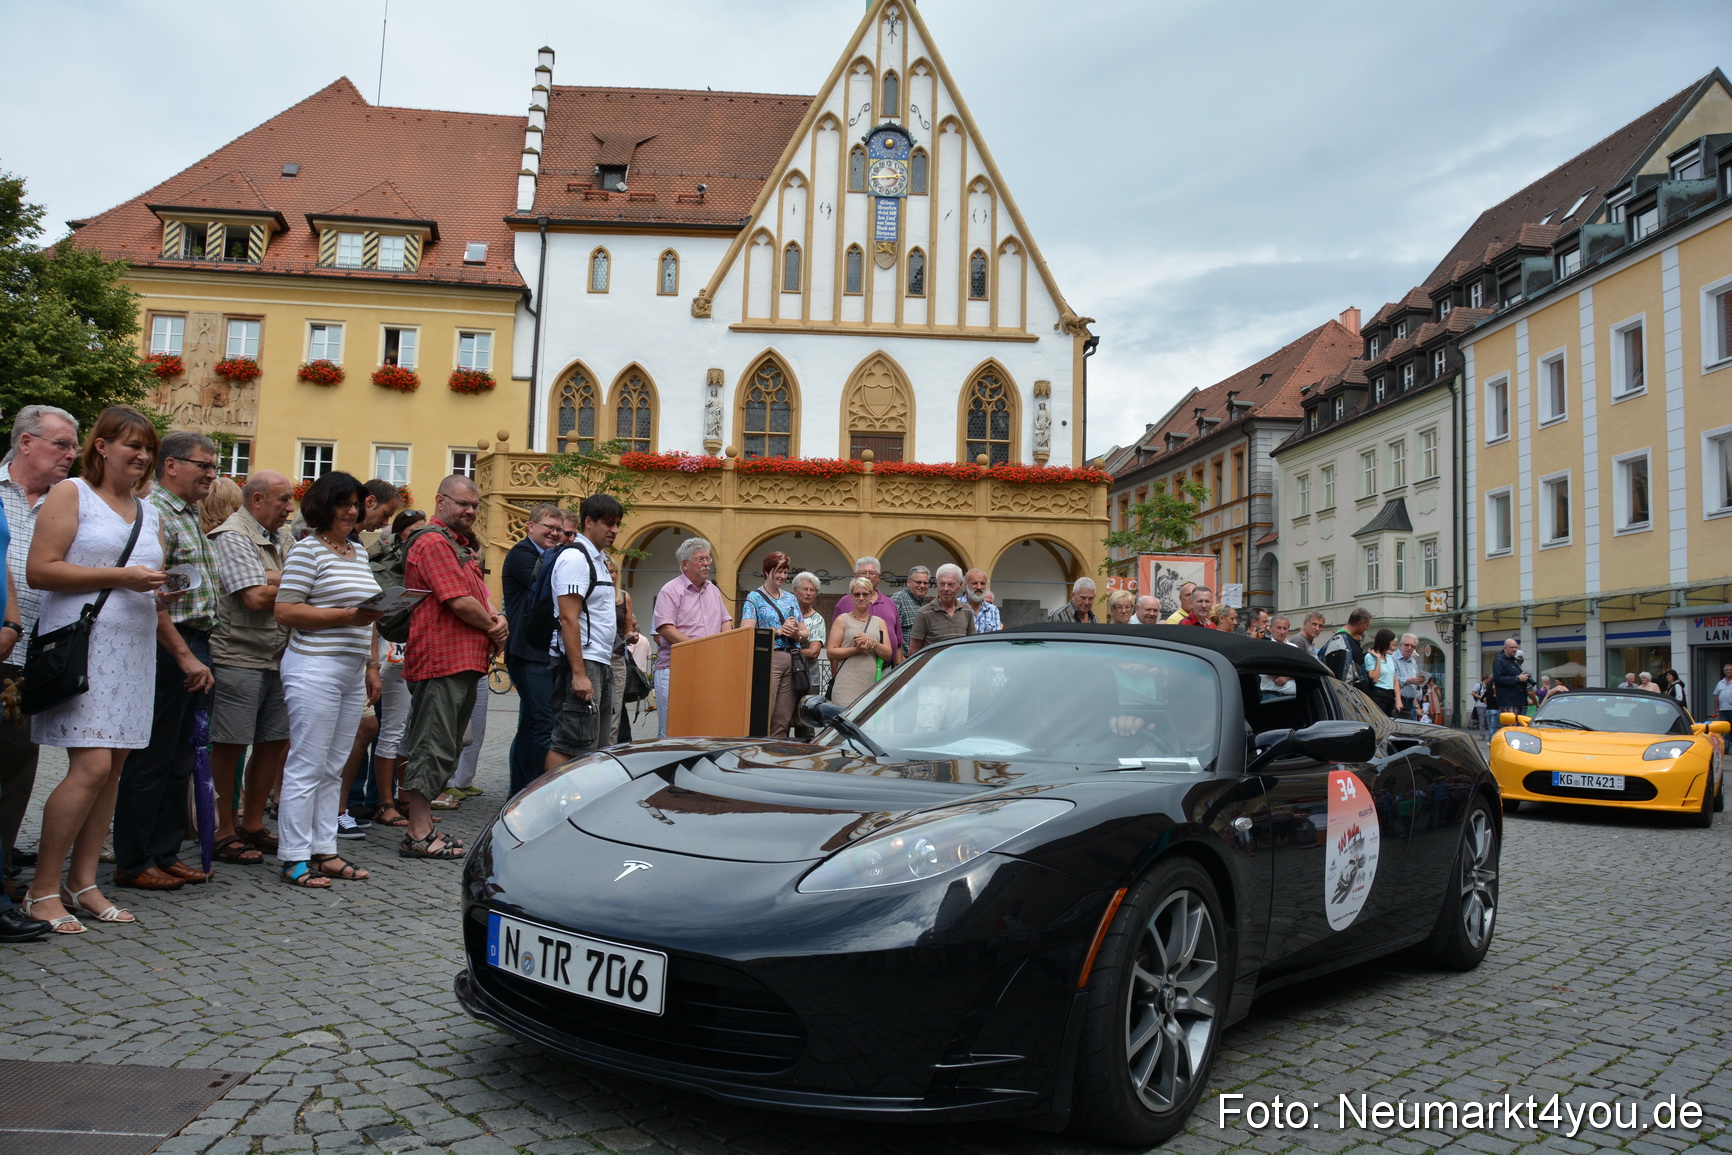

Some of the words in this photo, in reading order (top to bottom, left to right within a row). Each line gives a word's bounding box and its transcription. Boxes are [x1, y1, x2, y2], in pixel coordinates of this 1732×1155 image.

[1336, 777, 1356, 801] 34
[1560, 774, 1573, 785] KG
[1581, 775, 1594, 787] TR
[1595, 776, 1615, 788] 421
[490, 945, 496, 956] D
[505, 925, 521, 969] N
[538, 935, 572, 985] TR
[586, 948, 648, 1002] 706
